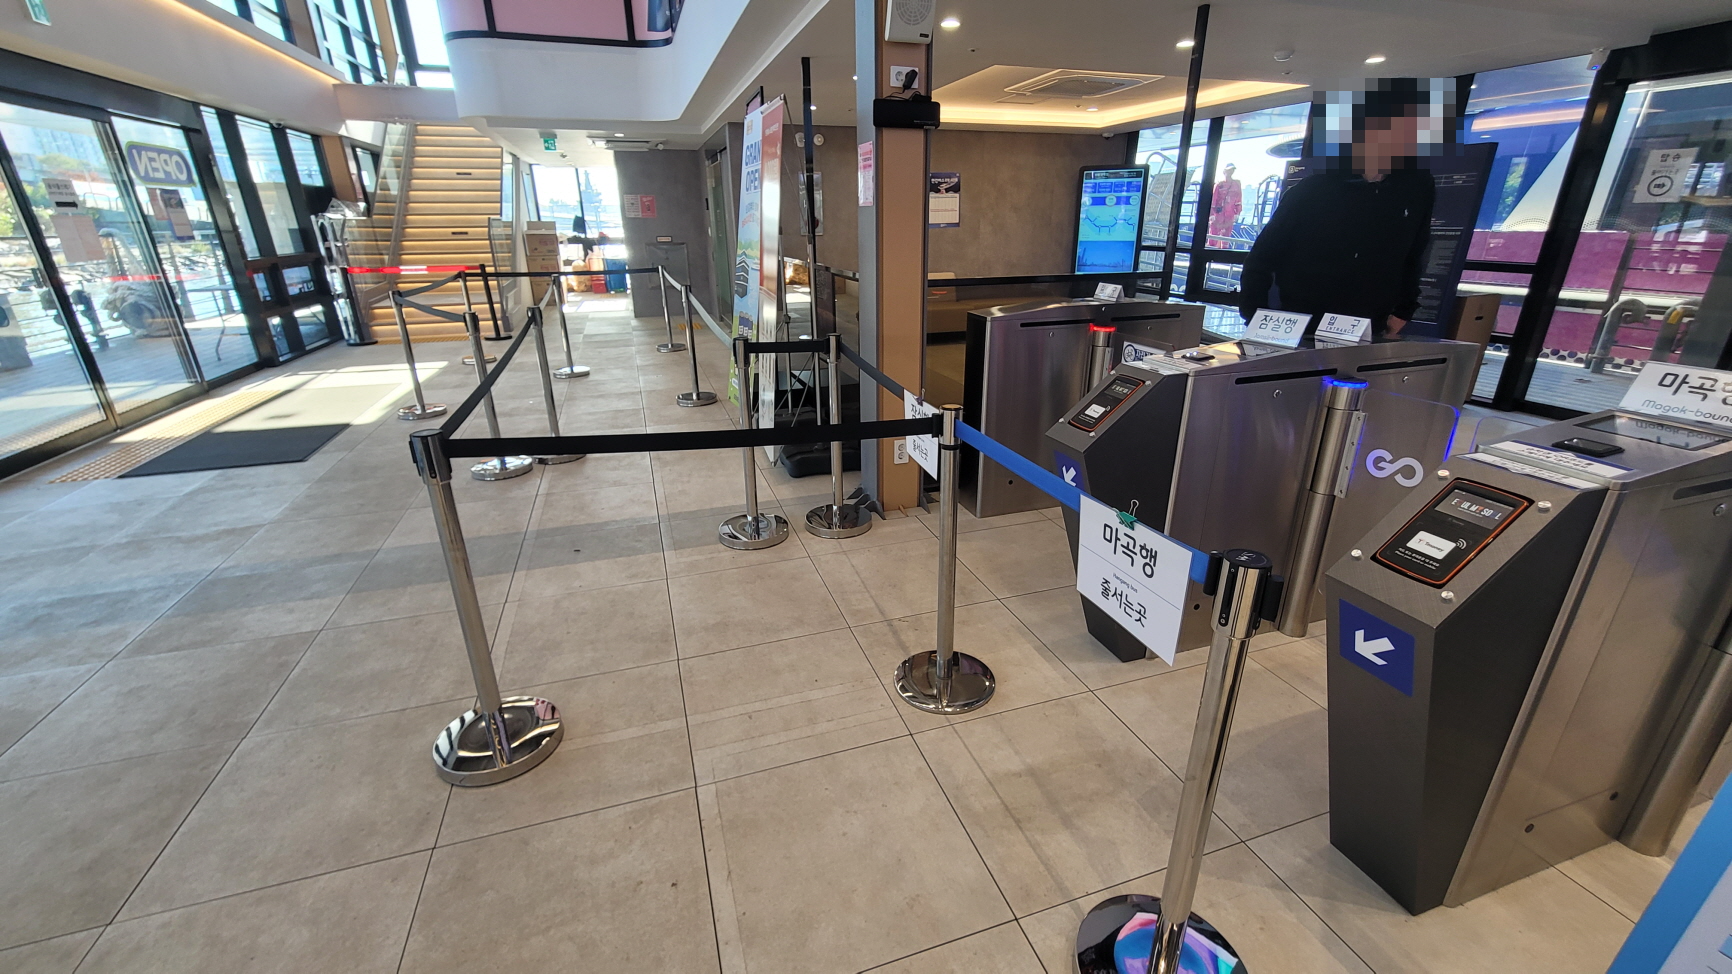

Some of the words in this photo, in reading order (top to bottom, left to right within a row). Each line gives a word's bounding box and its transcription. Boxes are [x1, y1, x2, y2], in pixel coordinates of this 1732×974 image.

[1258, 314, 1298, 334] 잠실행
[1325, 325, 1355, 335] ENTRANCE
[1327, 315, 1338, 326] 입
[1350, 319, 1361, 329] 구
[1641, 399, 1732, 424] Magok-boun
[1102, 522, 1158, 579] 마곡행
[1130, 584, 1138, 594] bus
[1100, 577, 1147, 628] 줄서는곳
